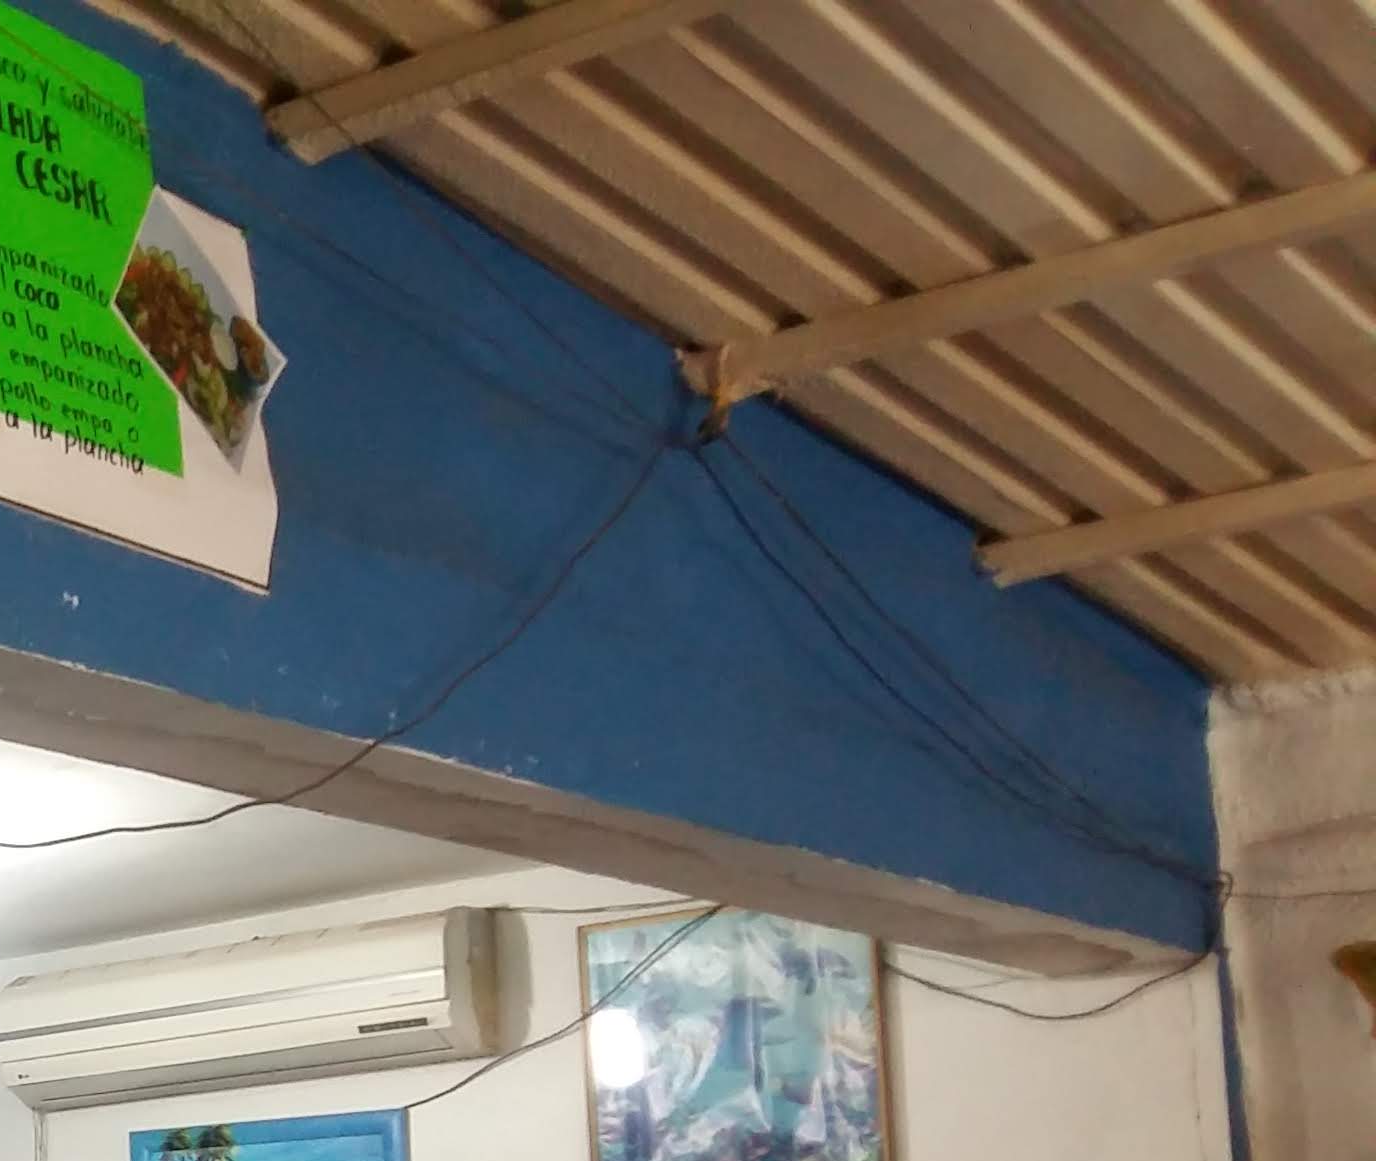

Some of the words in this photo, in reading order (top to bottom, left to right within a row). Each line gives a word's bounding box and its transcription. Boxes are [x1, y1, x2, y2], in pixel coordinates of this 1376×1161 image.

[16, 151, 112, 226] CESAR
[14, 278, 60, 312] coco
[2, 311, 17, 329] a
[26, 309, 49, 342] la
[59, 328, 144, 379] plancha
[10, 349, 140, 413] empanizado
[5, 409, 20, 430] a
[31, 412, 54, 443] la
[64, 425, 145, 475] plancha
[128, 426, 140, 444] o
